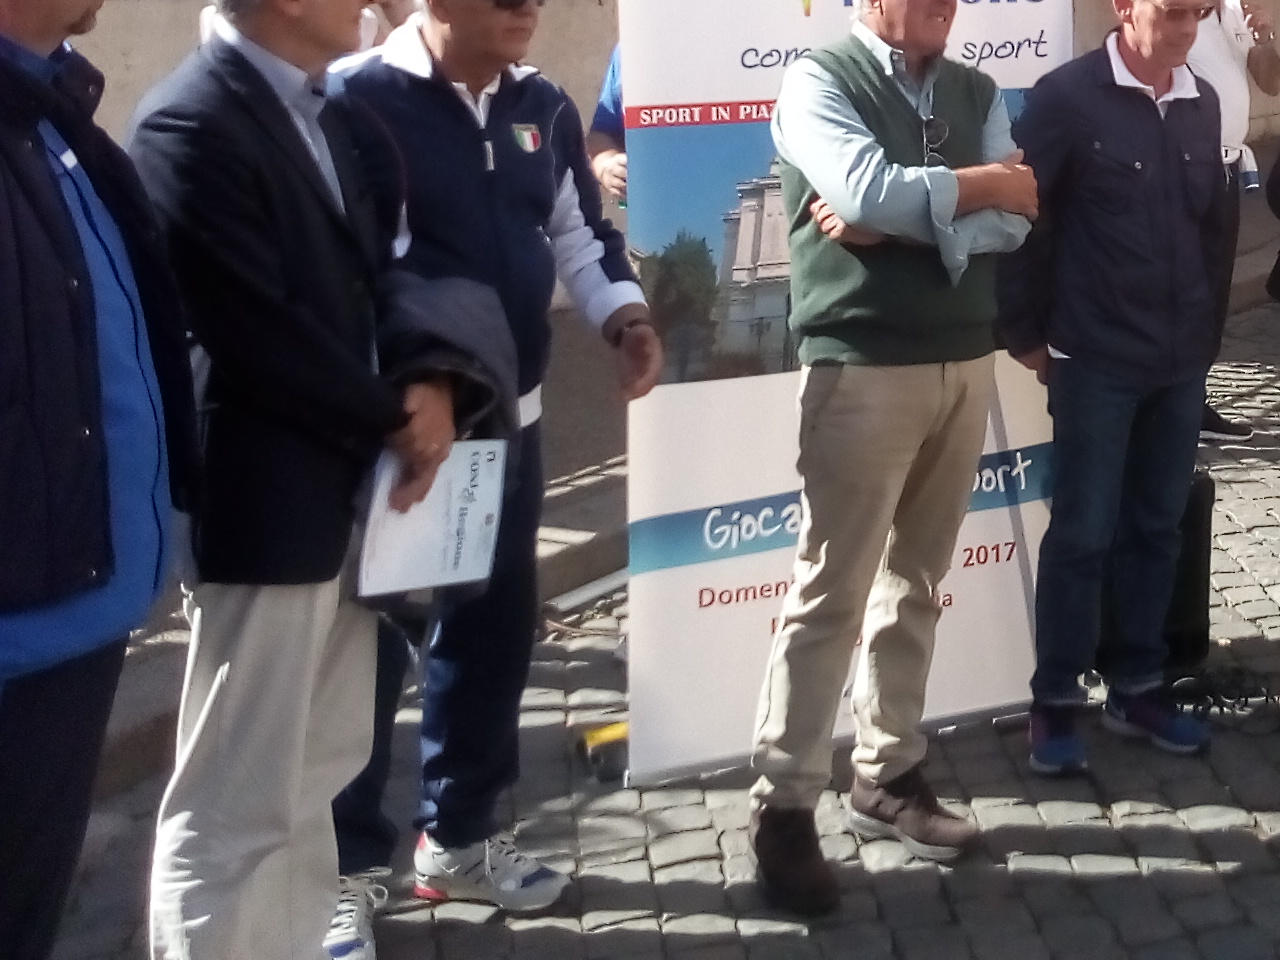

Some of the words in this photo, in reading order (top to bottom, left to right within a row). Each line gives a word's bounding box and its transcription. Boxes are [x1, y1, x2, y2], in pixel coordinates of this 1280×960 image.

[960, 29, 1049, 68] sport
[639, 106, 702, 126] SPORT
[711, 105, 731, 121] IN
[739, 103, 774, 120] PIA
[972, 451, 1032, 493] ort
[962, 541, 1017, 569] 2017
[698, 576, 795, 608] Domen
